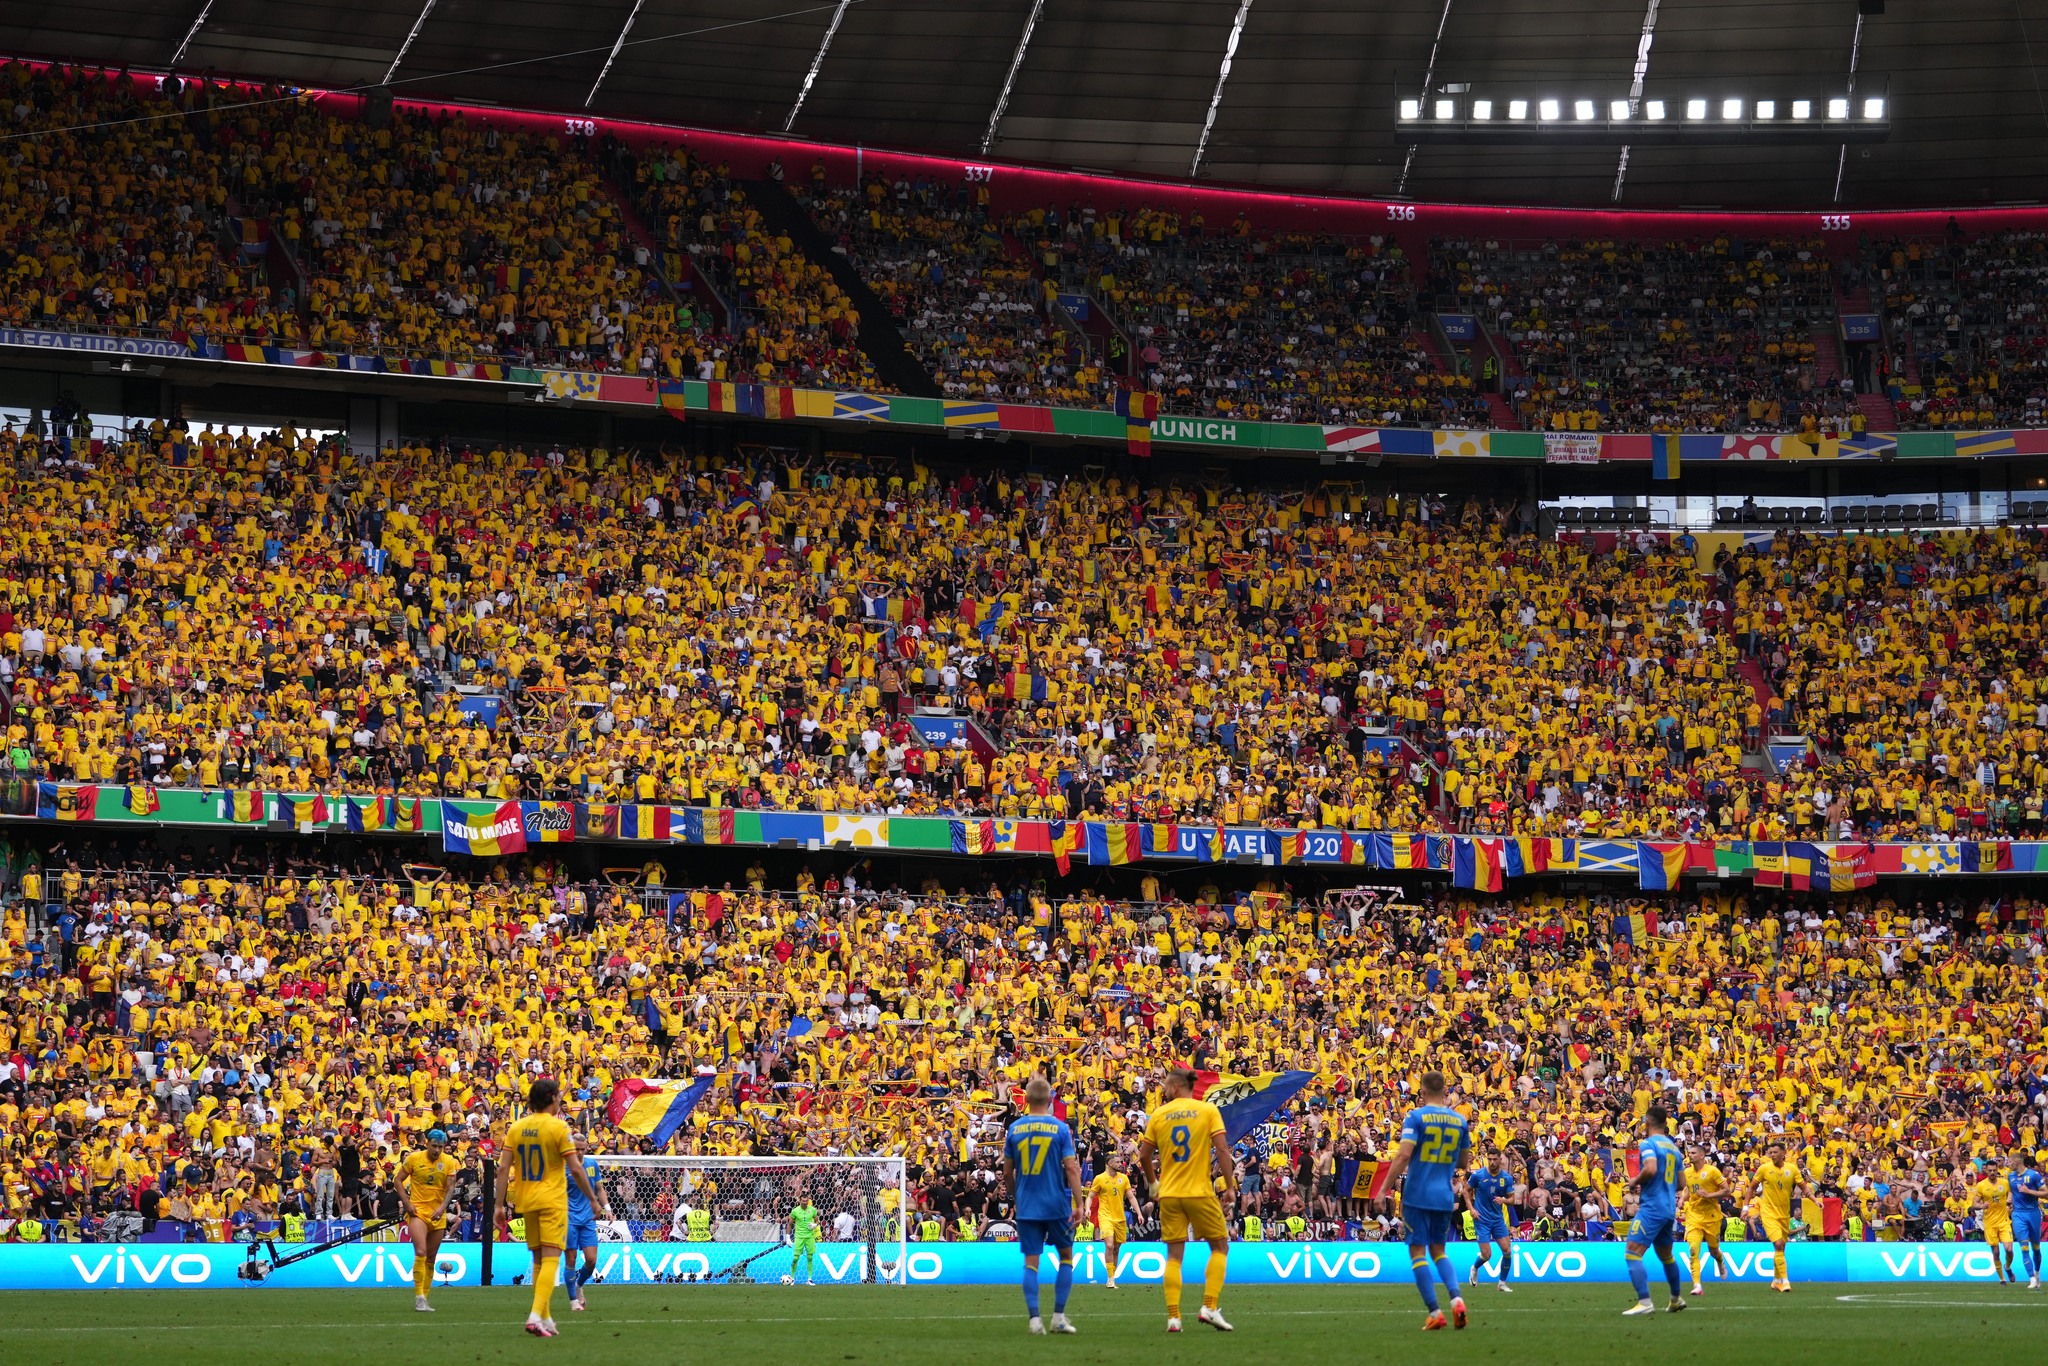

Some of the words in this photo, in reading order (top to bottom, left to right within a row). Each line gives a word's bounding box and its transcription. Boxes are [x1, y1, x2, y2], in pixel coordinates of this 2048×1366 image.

[565, 119, 595, 136] 338
[965, 166, 993, 182] 337
[1387, 205, 1416, 221] 336
[1821, 215, 1850, 230] 335
[1062, 305, 1079, 314] 37
[1446, 325, 1465, 333] 336
[1850, 326, 1870, 334] 335
[1150, 420, 1236, 440] MUNICH
[925, 731, 947, 740] 239
[446, 819, 479, 840] SATU
[480, 817, 520, 840] MARE
[525, 811, 572, 833] Arad
[1170, 1125, 1191, 1163] 9
[1419, 1126, 1461, 1164] 22
[517, 1144, 545, 1182] 10
[1017, 1136, 1053, 1176] 17
[1664, 1153, 1677, 1185] 8
[426, 1175, 434, 1186] 2
[1499, 1178, 1505, 1187] 9
[70, 1245, 211, 1284] vivo
[331, 1245, 467, 1282] vivo
[819, 1245, 943, 1280] vivo
[1266, 1244, 1381, 1278] vivo
[1477, 1244, 1587, 1278] vivo
[1881, 1244, 1997, 1277] vivo
